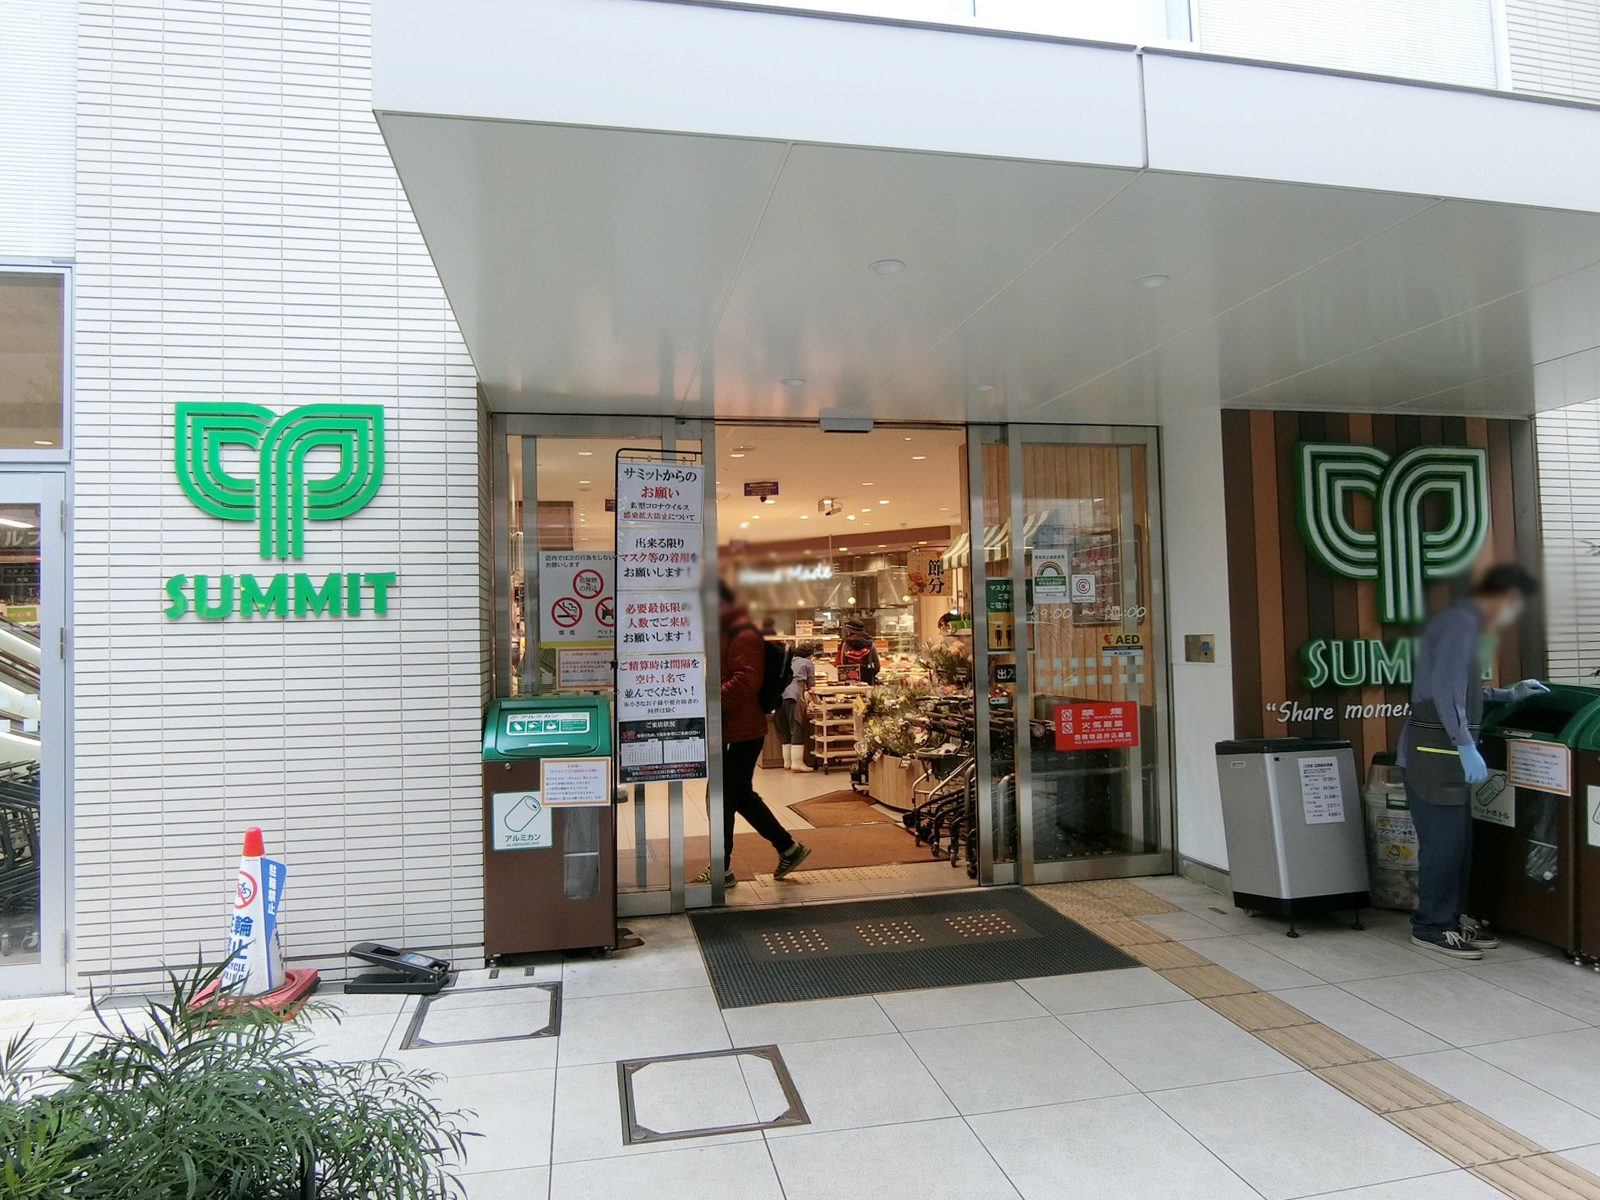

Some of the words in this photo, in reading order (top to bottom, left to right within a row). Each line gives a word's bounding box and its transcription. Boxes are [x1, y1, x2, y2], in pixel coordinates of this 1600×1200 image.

[624, 467, 697, 483] サミットからの
[641, 486, 680, 499] お願い
[623, 511, 695, 521] 感染拡大防止について
[635, 538, 684, 549] 出来る限り
[619, 552, 698, 563] マスク等の着用を
[164, 571, 397, 619] SUMMIT
[625, 602, 692, 614] 必要最低限の
[1040, 608, 1072, 619] 9:00
[627, 616, 691, 629] 人数でご来店
[1115, 634, 1140, 645] AED
[619, 658, 700, 671] ご精算時は間隔を
[635, 673, 686, 685] 空け、1名で
[623, 685, 695, 699] 並んでください！
[505, 834, 541, 843] アルミカン
